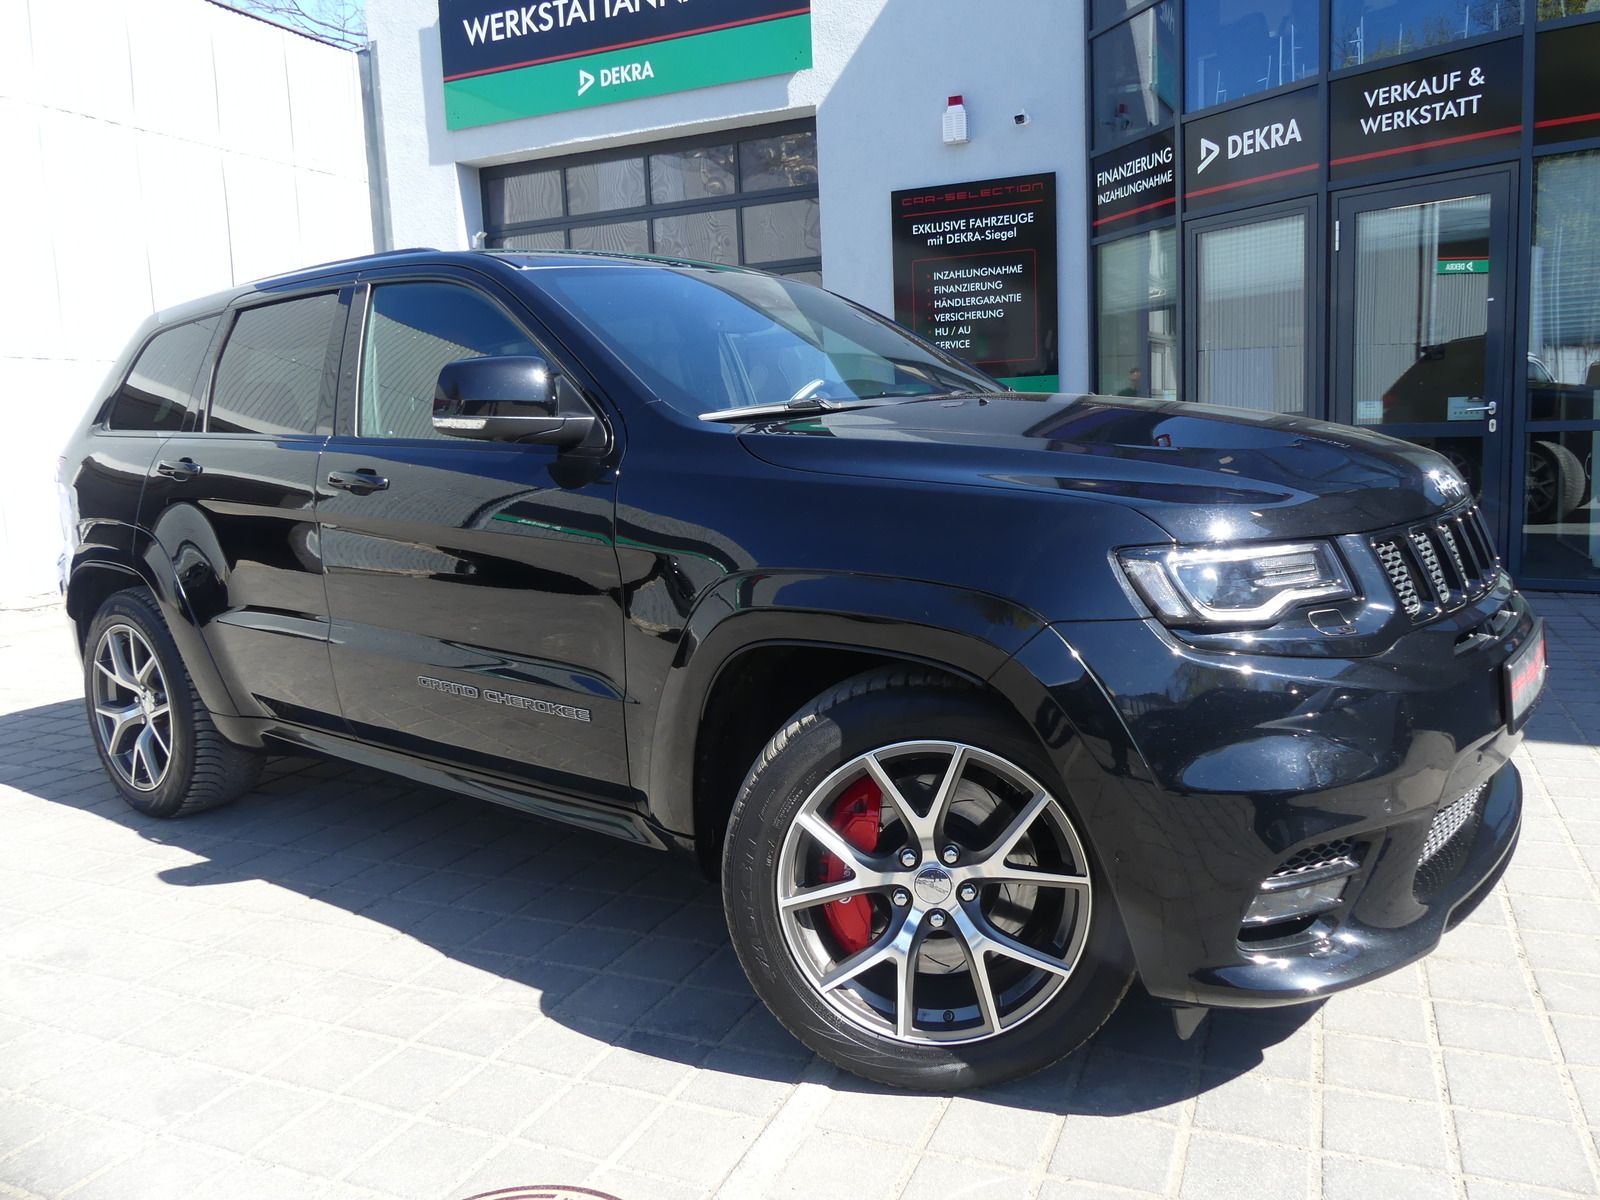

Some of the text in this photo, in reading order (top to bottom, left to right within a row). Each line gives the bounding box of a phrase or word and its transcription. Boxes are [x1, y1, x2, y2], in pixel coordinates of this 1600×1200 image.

[600, 61, 654, 88] DEKRA
[1364, 66, 1486, 108] VERKAUF &
[1360, 94, 1482, 136] WERKSTATT
[1227, 118, 1302, 160] DEKRA
[1097, 147, 1173, 188] FINANZIERUNG
[902, 182, 1044, 206] CAR-SELECTION
[1097, 169, 1173, 206] INZAHLUNGNAHME
[912, 212, 1034, 235] EXKLUSIVE FAHRZEUGE
[927, 227, 1017, 246] mit DEKRA-Siegel
[933, 264, 1023, 281] INZAHLUNGNAHME
[934, 280, 1003, 294] FINANZIERUNG
[934, 293, 1022, 309] HÄNDLERGARANTIE
[934, 309, 1004, 322] VERSICHERUNG
[935, 327, 949, 336] HU
[957, 325, 971, 335] AU
[418, 675, 591, 722] GRAND CHEROKEE
